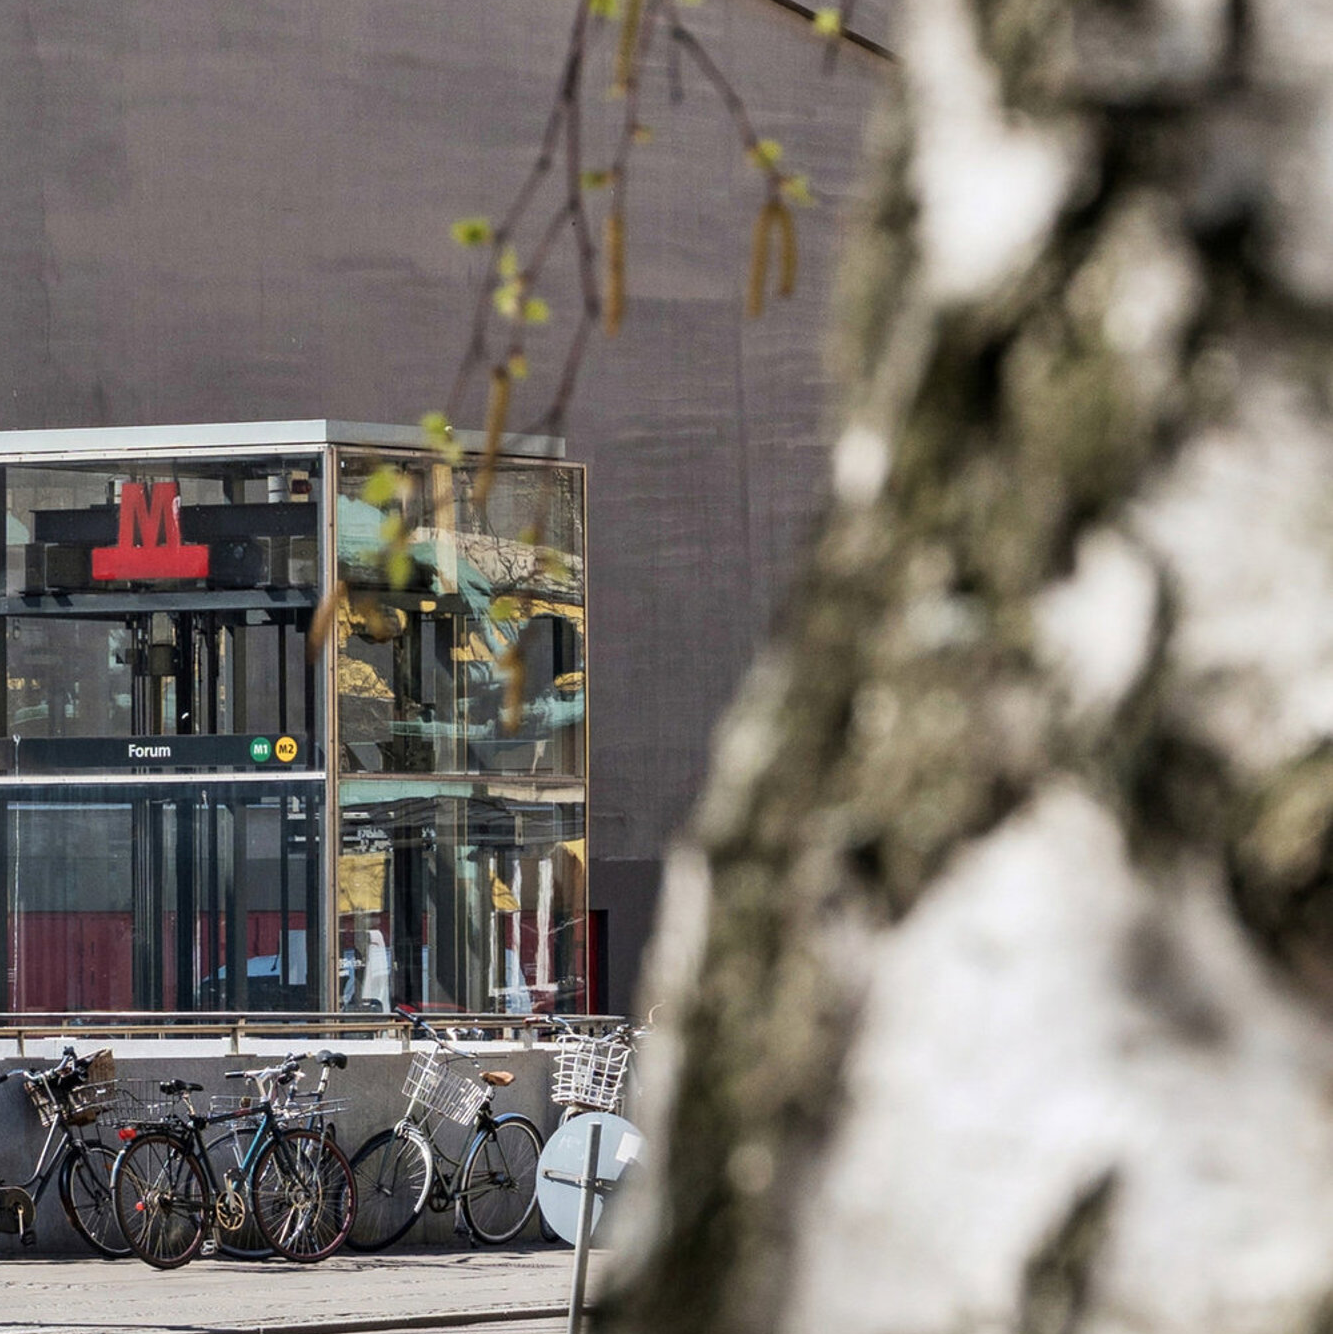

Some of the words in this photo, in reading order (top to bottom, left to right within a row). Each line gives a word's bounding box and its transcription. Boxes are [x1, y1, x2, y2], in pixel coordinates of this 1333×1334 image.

[128, 744, 171, 758] Forum
[253, 744, 268, 755] M1
[278, 744, 294, 754] M2
